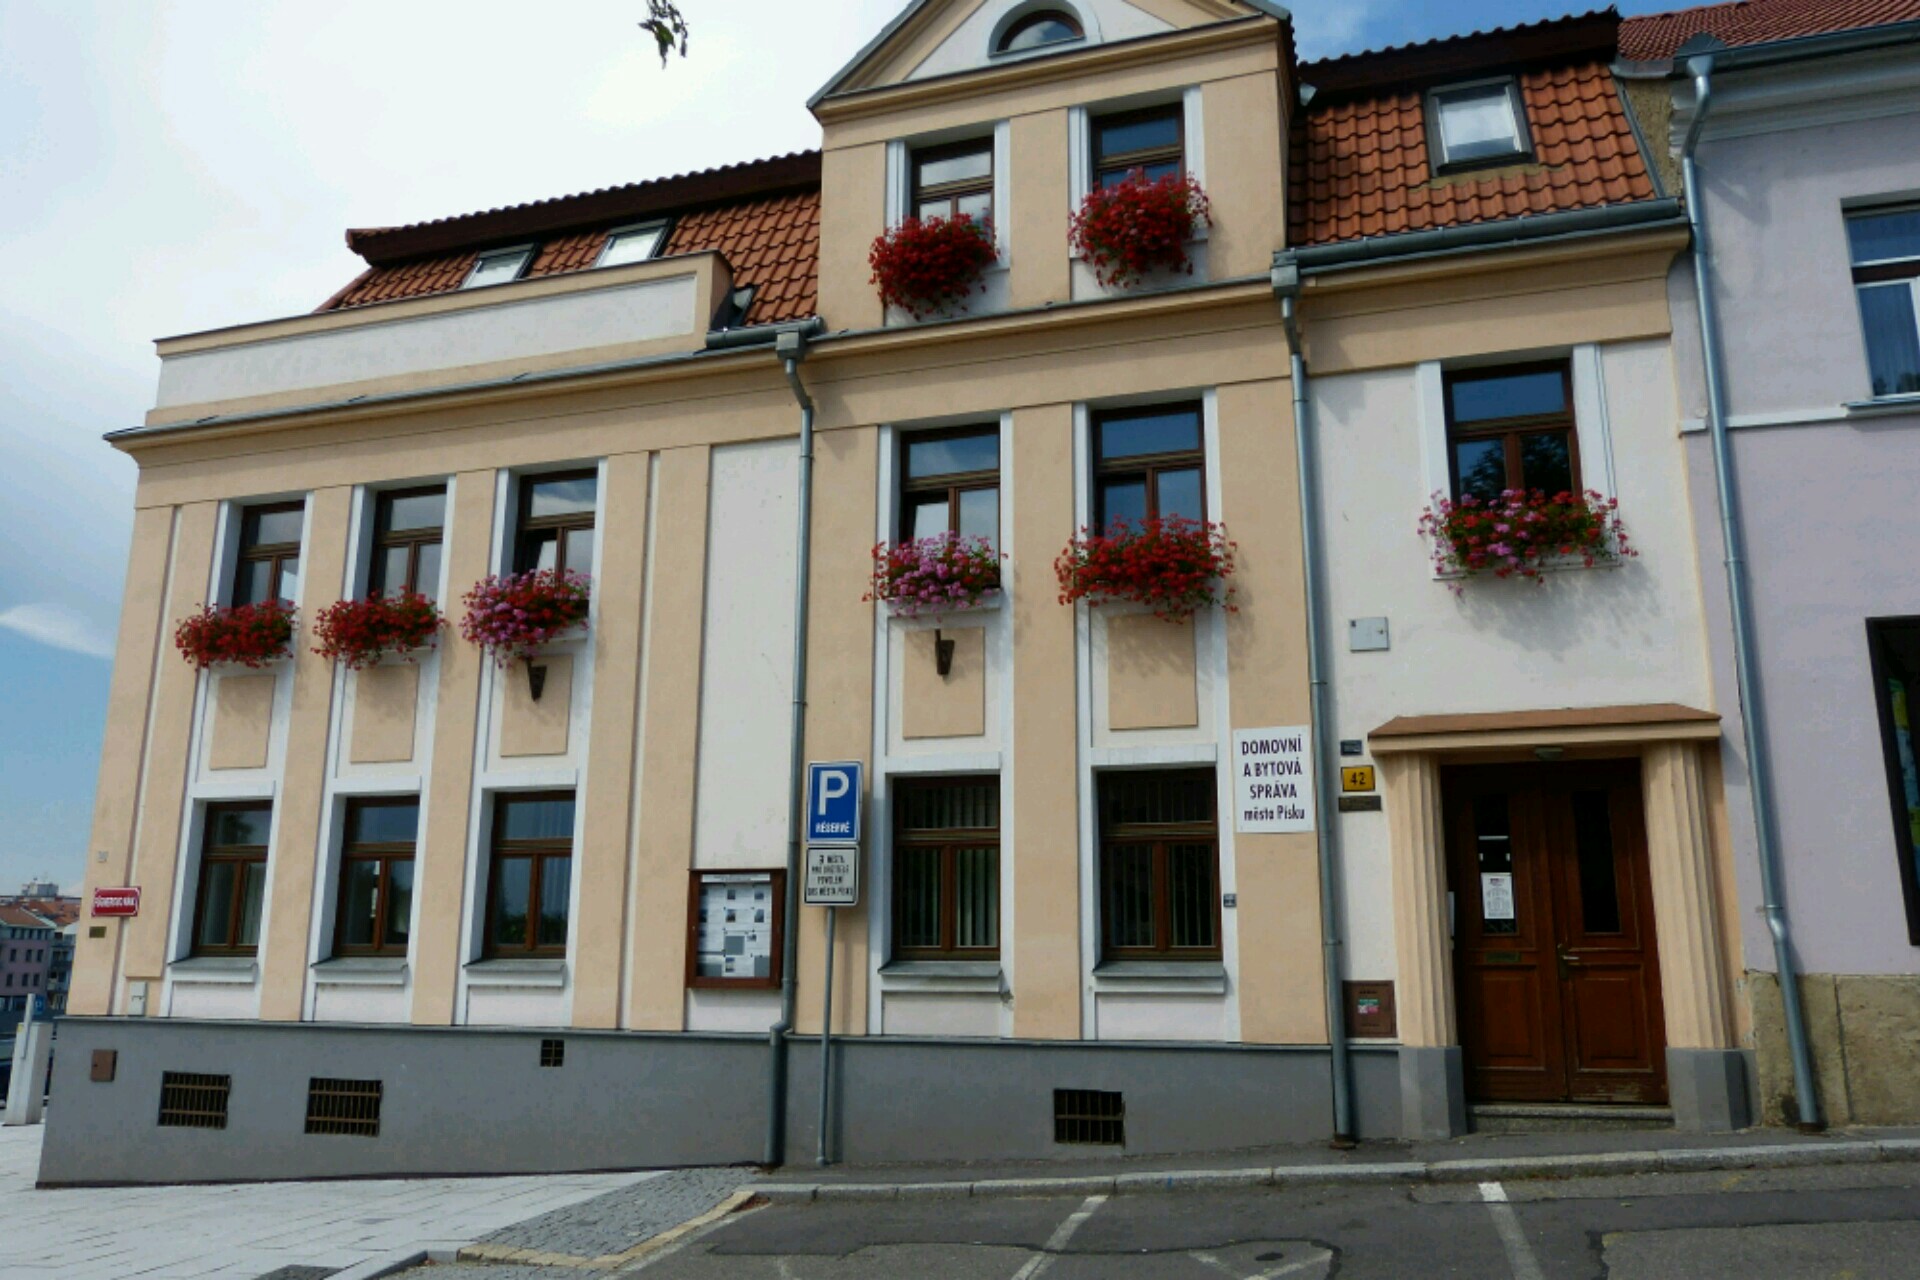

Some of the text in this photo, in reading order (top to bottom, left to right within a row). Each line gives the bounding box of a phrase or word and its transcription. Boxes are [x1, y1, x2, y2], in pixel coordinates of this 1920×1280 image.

[1241, 734, 1302, 756] DOMOVNÍ
[1243, 757, 1302, 777] A BYTOVÁ
[1350, 772, 1366, 785] 42
[818, 769, 849, 816] P
[1249, 780, 1297, 800] SPRÁVA
[1243, 803, 1305, 821] města Písku
